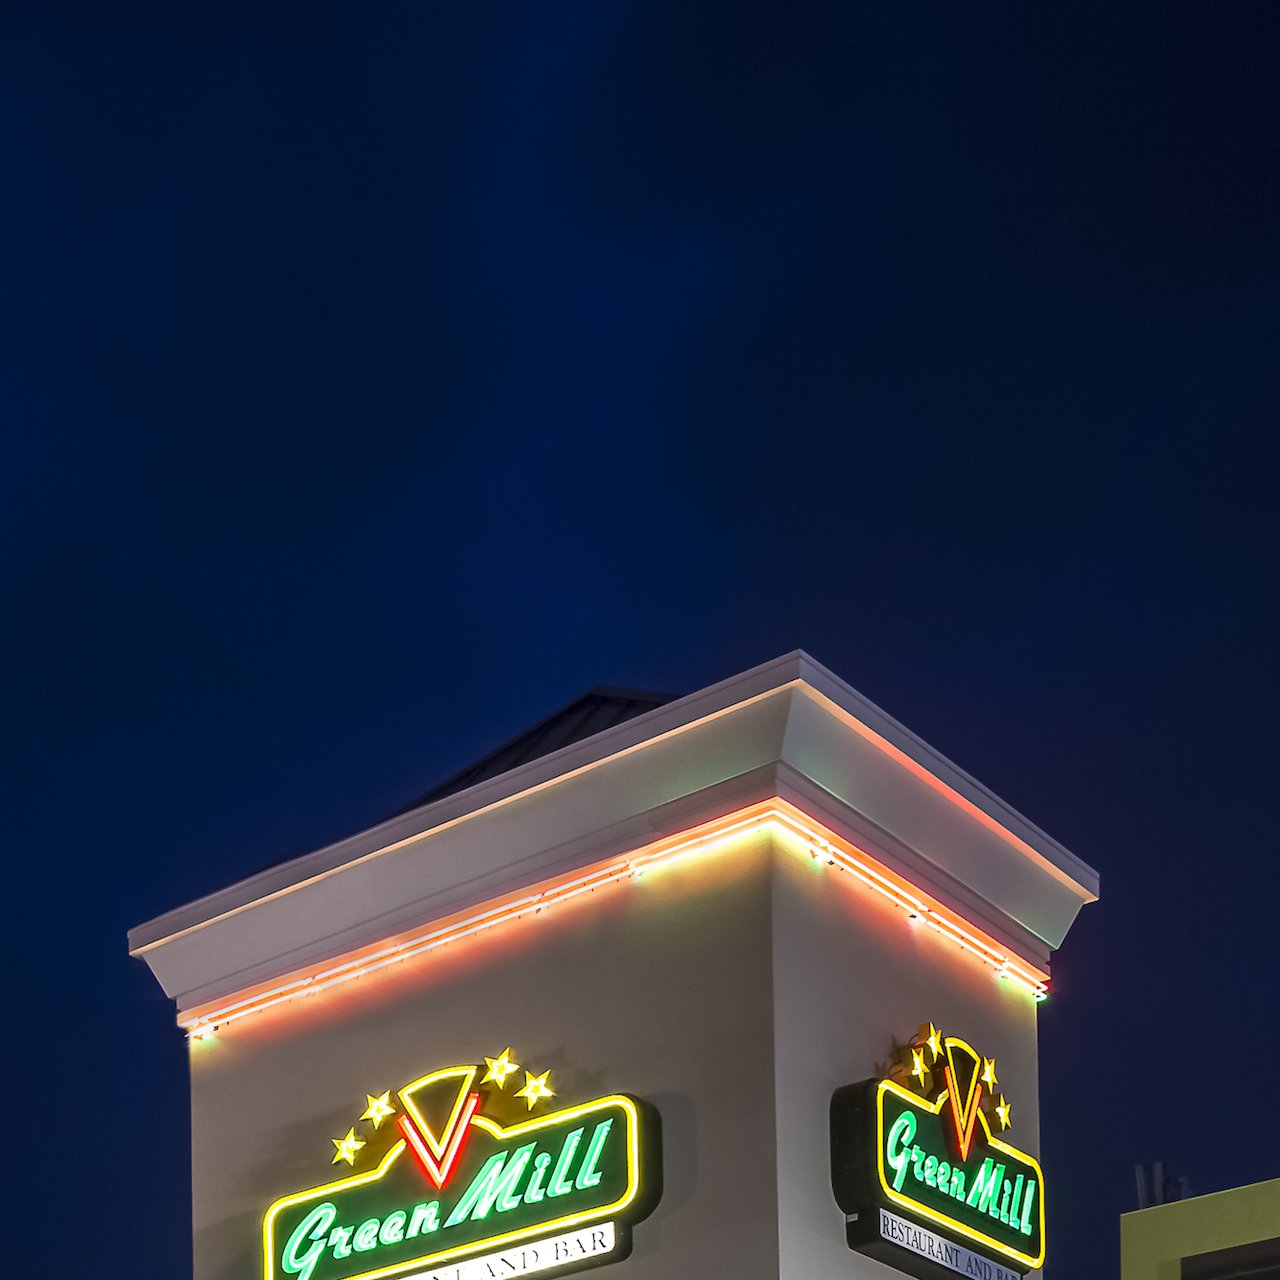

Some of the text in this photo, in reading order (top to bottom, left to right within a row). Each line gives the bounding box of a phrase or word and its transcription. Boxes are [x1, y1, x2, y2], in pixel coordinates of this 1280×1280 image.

[442, 1117, 614, 1230] Mill
[886, 1110, 1036, 1236] Green Mill
[479, 1249, 540, 1280] AND
[554, 1228, 608, 1262] BAR
[881, 1214, 961, 1268] RESTAURANT
